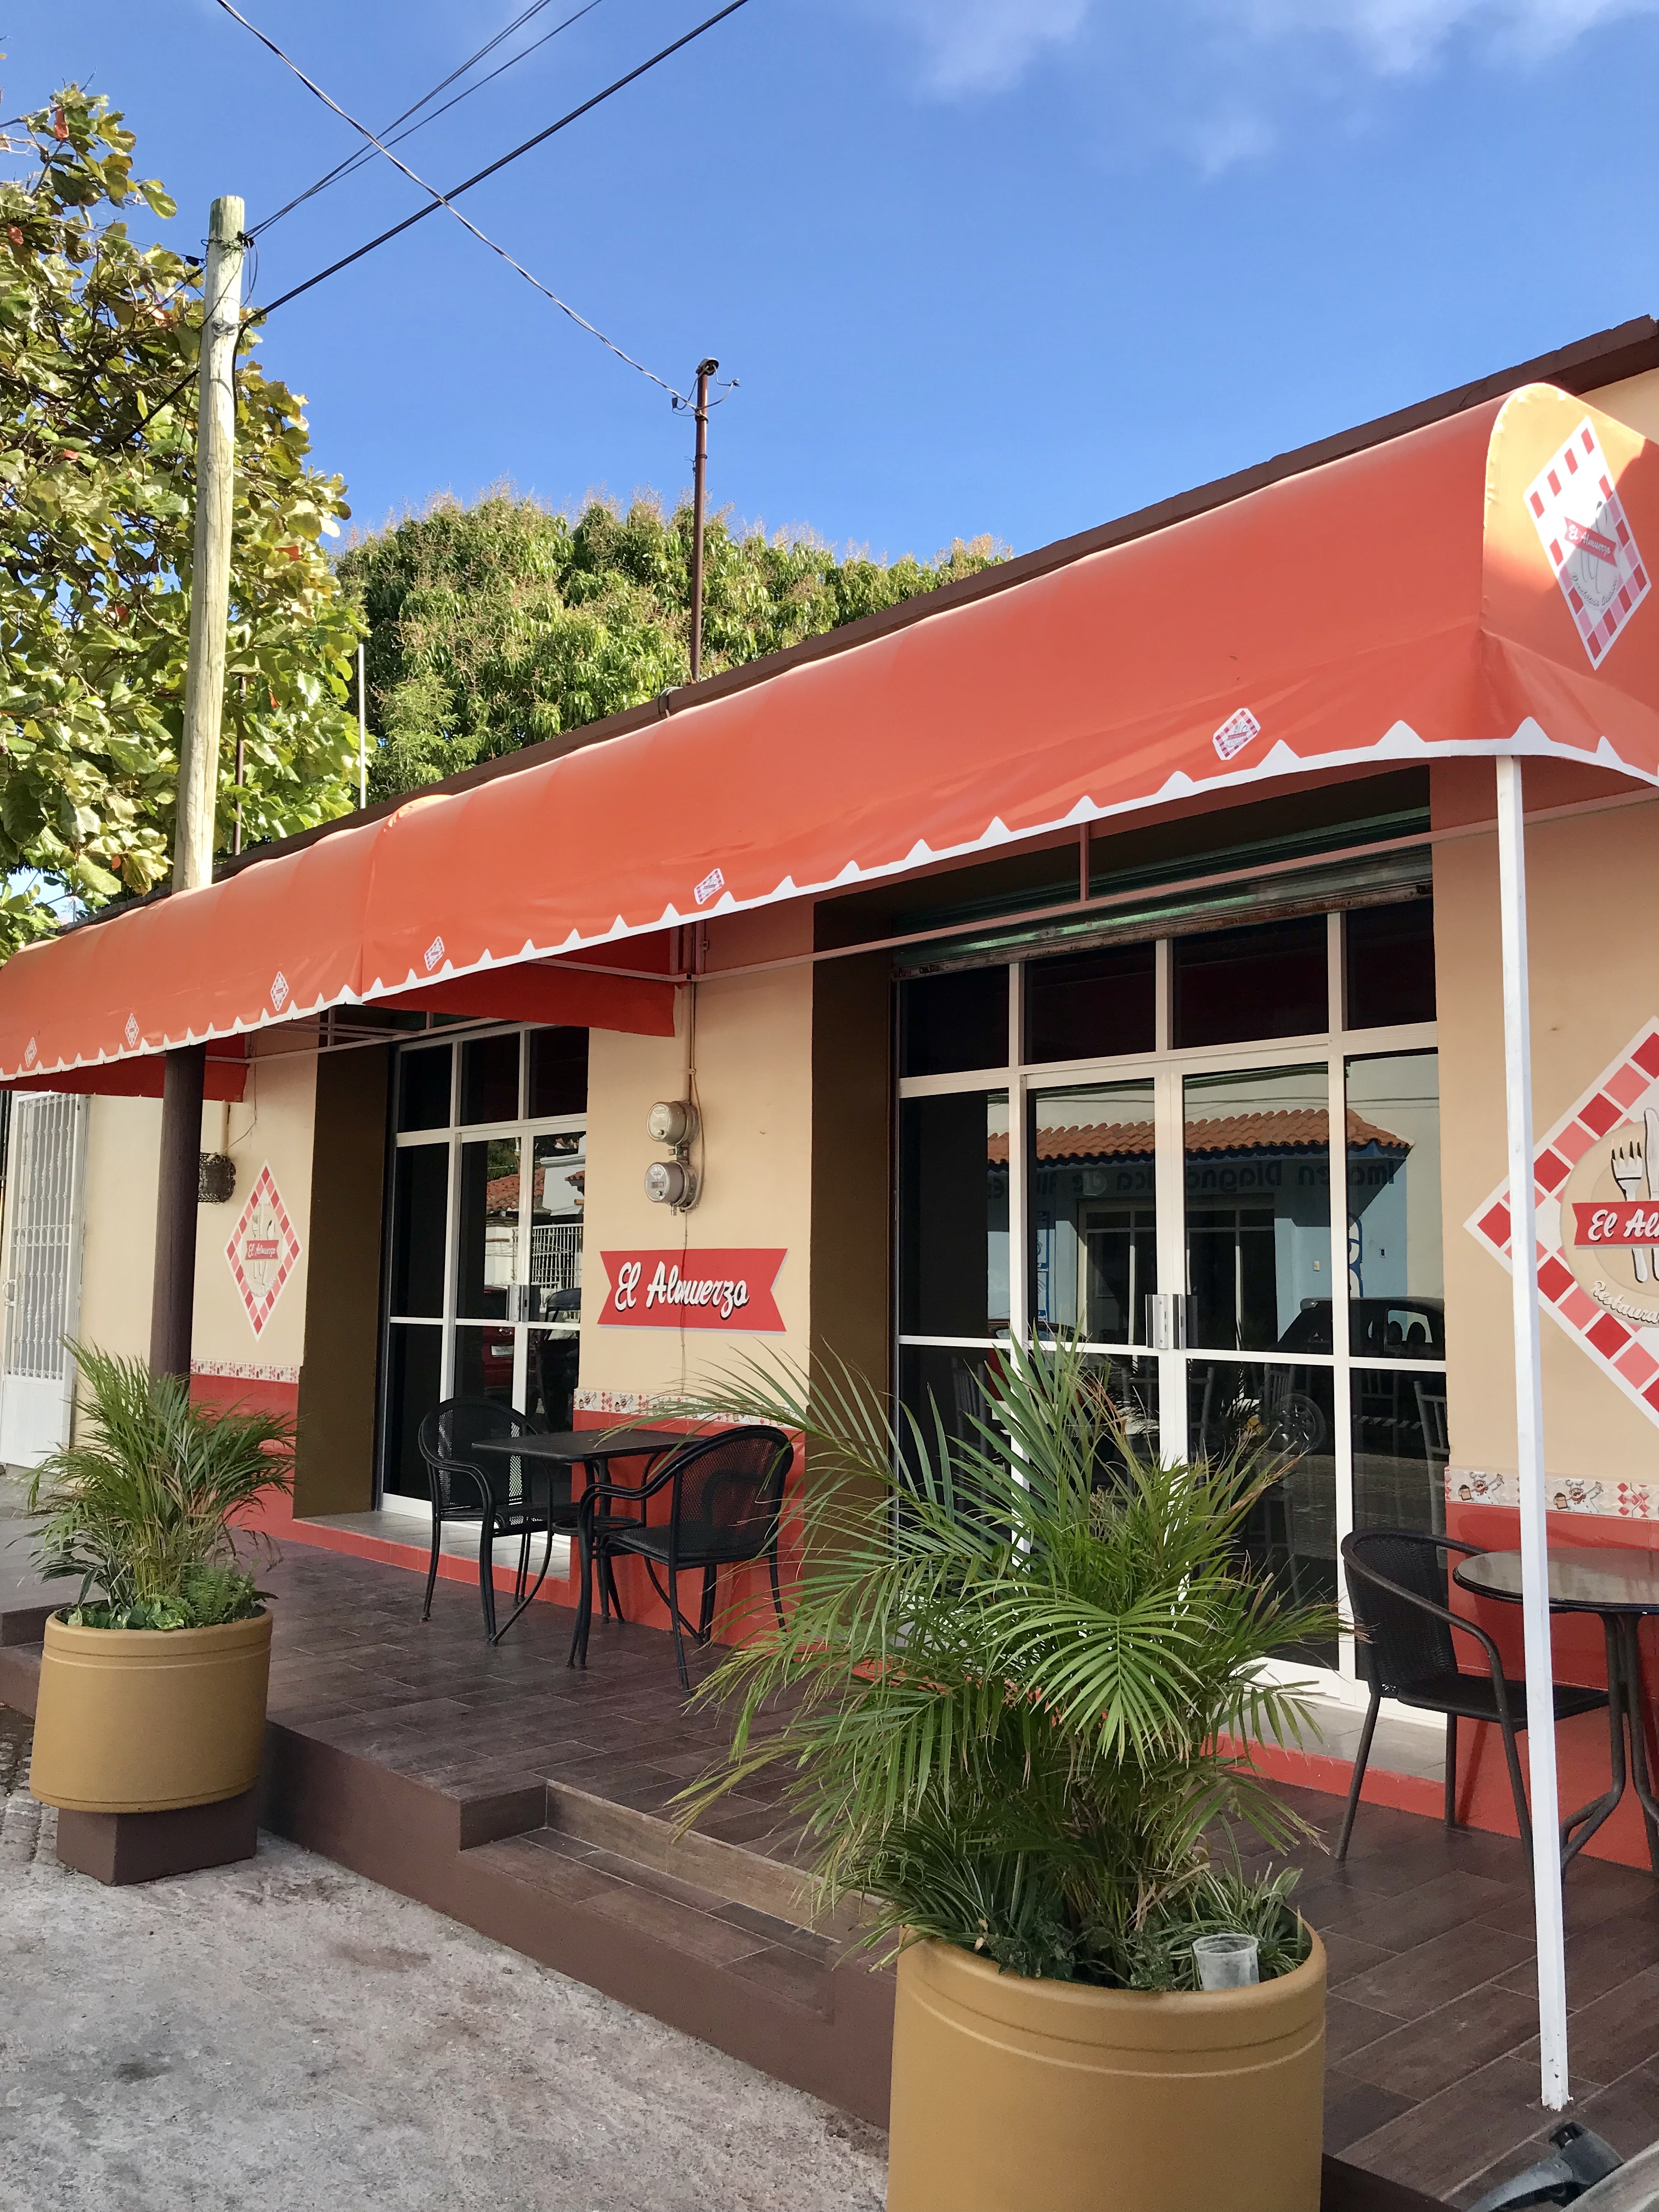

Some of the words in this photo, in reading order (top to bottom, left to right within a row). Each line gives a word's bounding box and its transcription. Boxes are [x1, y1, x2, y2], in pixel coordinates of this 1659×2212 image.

[1588, 1209, 1618, 1242] El
[1623, 1209, 1659, 1238] Al
[614, 1261, 641, 1311] El
[646, 1260, 750, 1319] Almuerzo
[1590, 1280, 1659, 1324] Restaura
